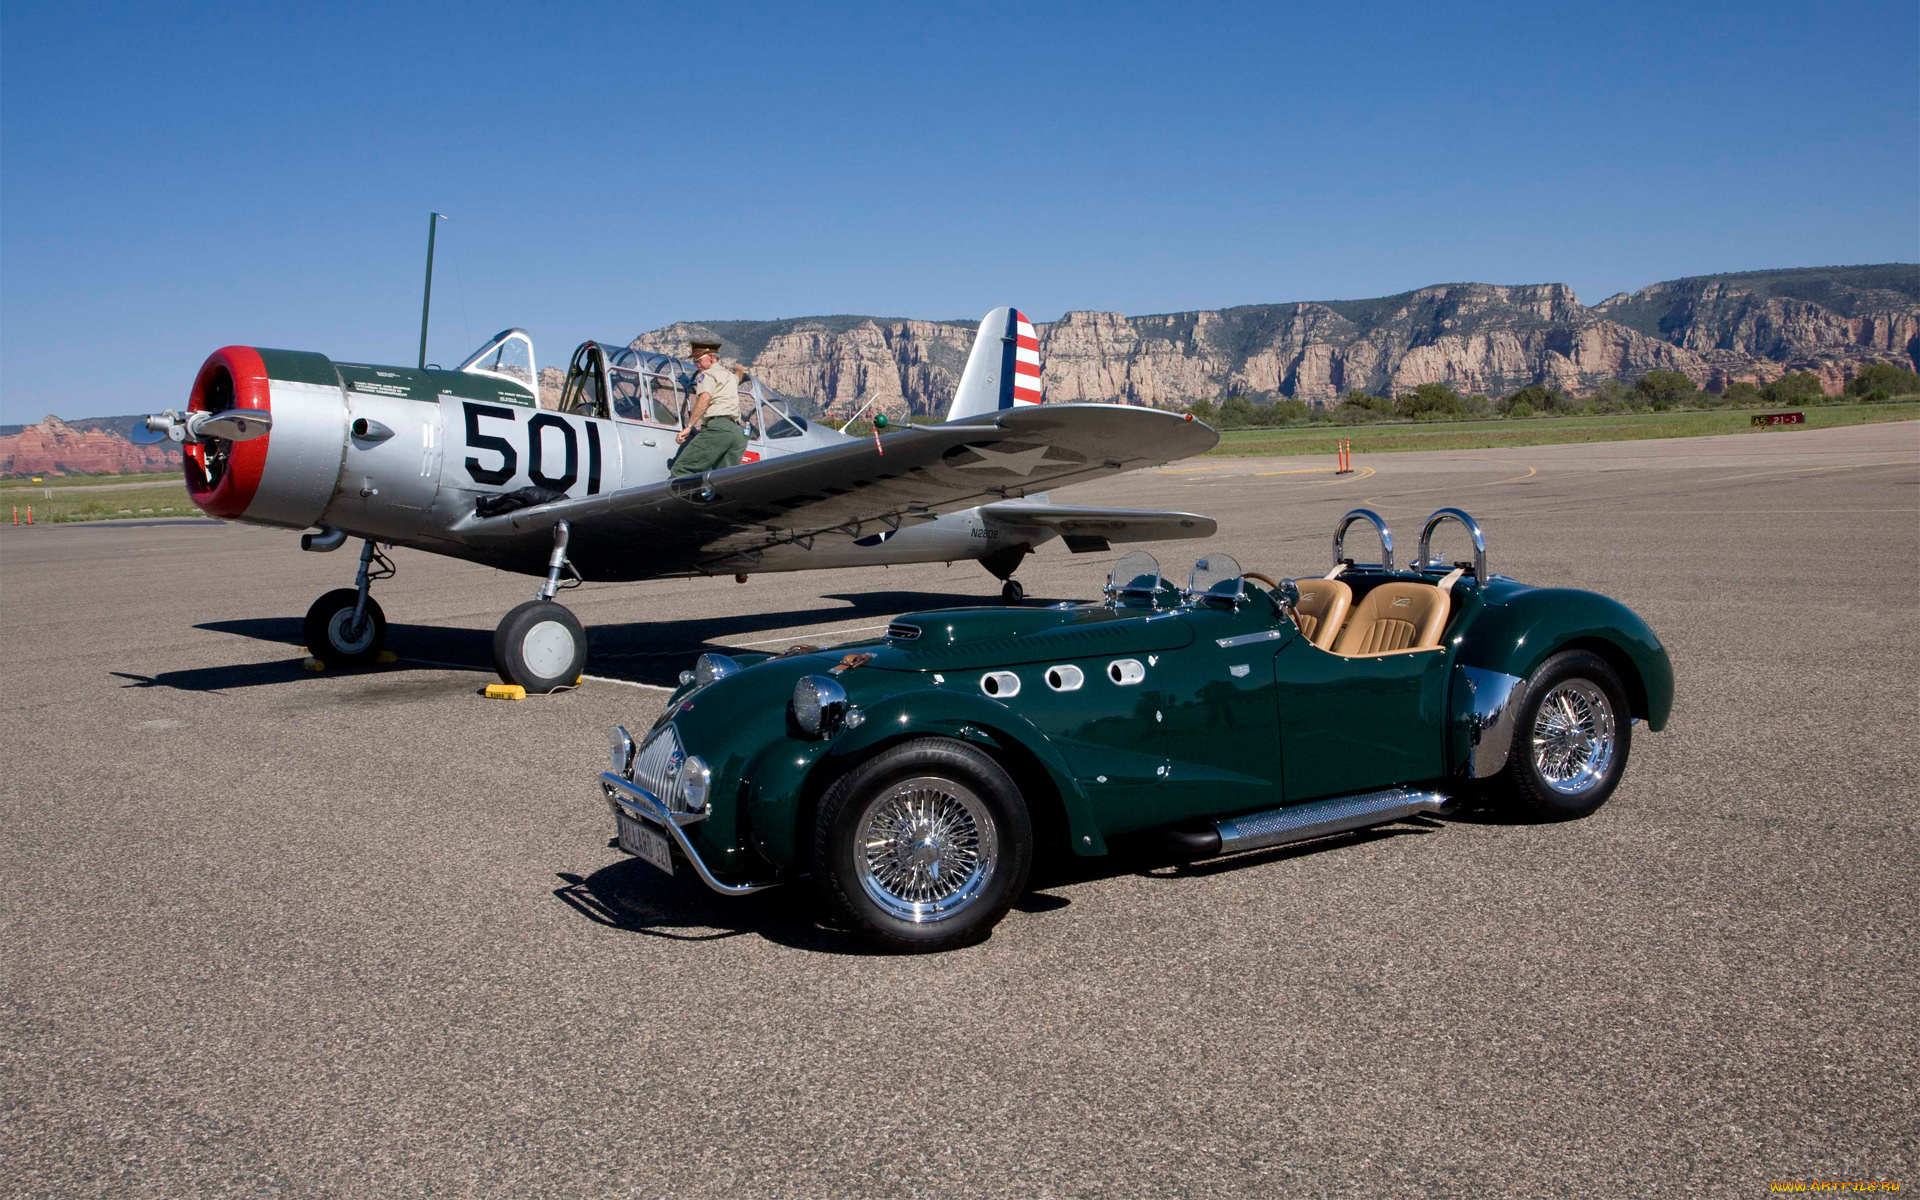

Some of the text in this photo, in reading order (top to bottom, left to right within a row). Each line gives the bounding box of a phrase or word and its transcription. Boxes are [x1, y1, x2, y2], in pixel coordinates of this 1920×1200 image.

[1753, 415, 1797, 427] A5 21-3
[462, 401, 602, 496] 501
[971, 528, 999, 539] N2808
